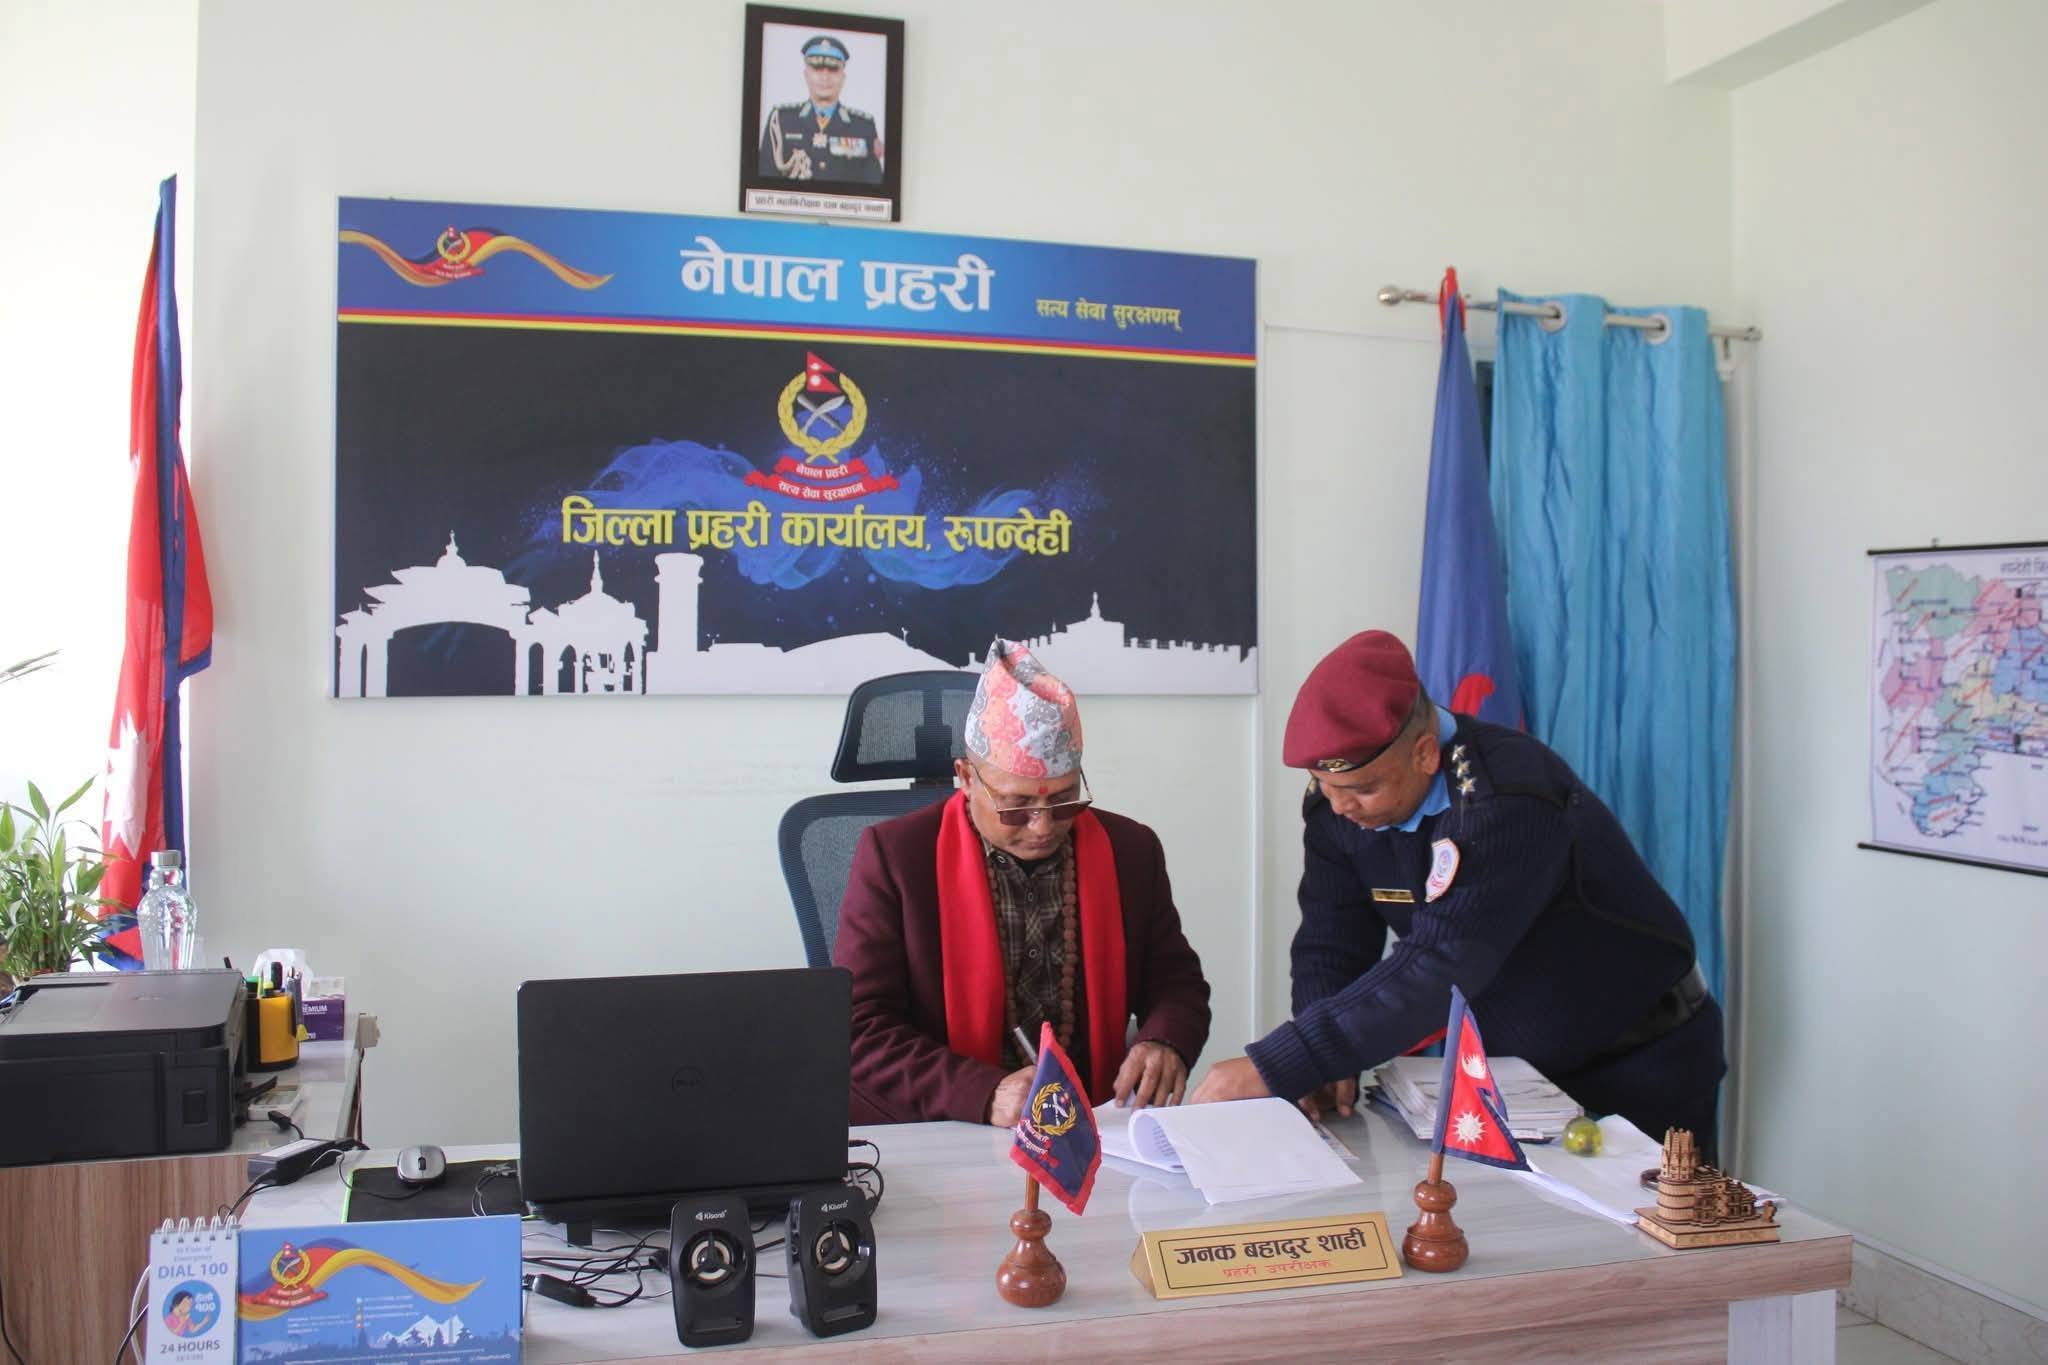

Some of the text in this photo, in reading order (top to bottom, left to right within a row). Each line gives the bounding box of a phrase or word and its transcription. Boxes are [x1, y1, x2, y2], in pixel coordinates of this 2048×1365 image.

[679, 235, 996, 313] नेपाल प्रहरी
[1036, 299, 1069, 318] सत्य
[1075, 297, 1107, 320] सेवा
[561, 496, 674, 545] जिल्ला
[687, 501, 770, 549] प्रहरी
[781, 504, 931, 552] कार्यालय,
[1174, 1226, 1367, 1265] जनक बहादुर शाही
[158, 1262, 228, 1279] DIAL 100
[1223, 1263, 1257, 1278] प्रहरी
[160, 1339, 221, 1354] 24 HOURS
